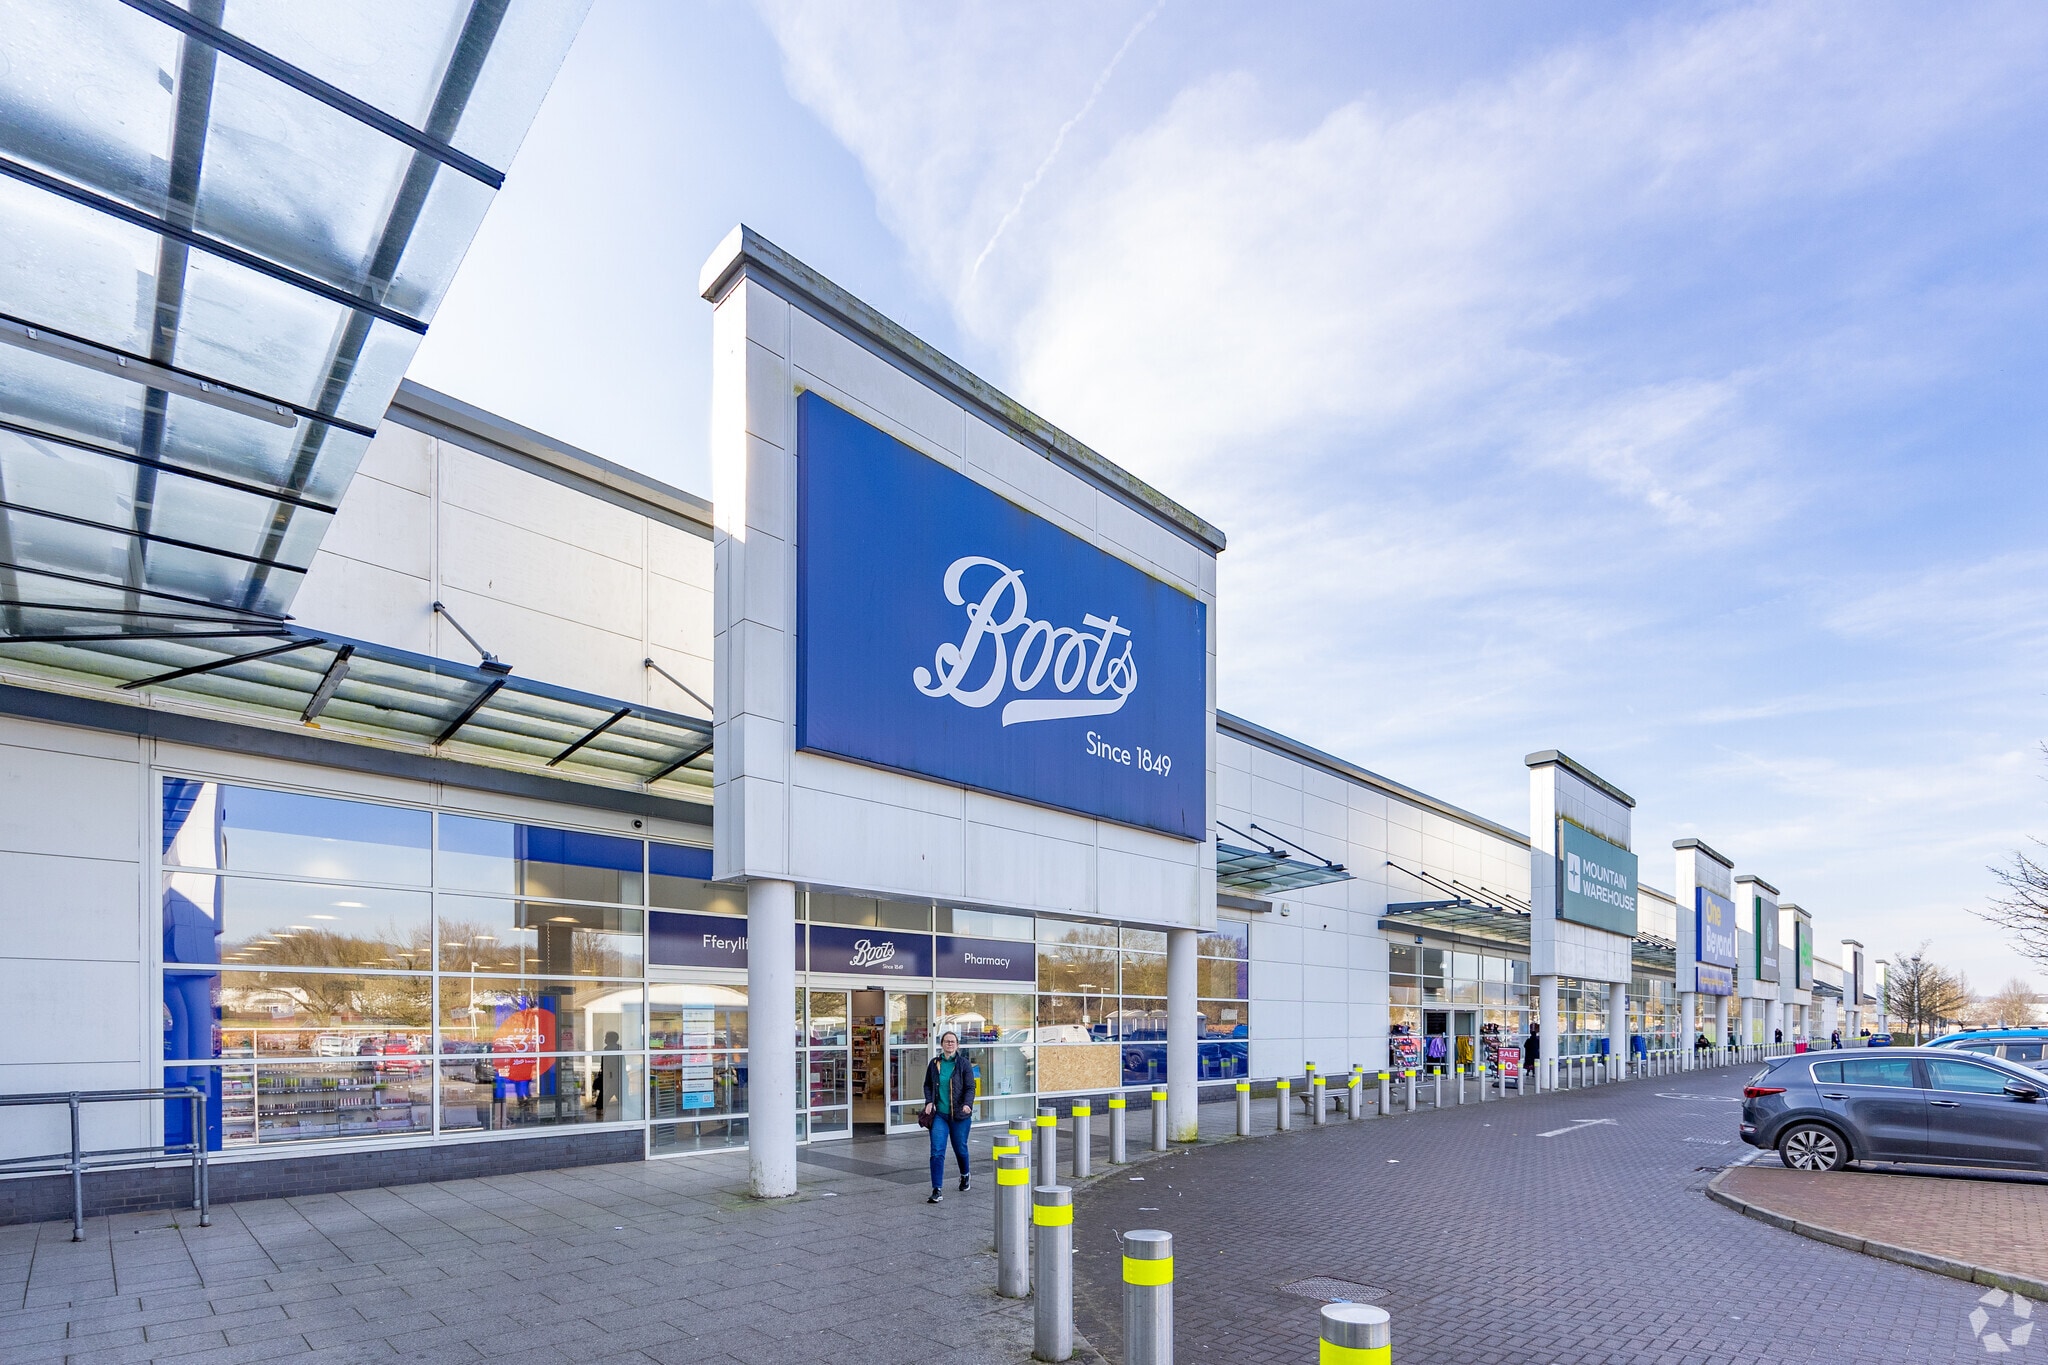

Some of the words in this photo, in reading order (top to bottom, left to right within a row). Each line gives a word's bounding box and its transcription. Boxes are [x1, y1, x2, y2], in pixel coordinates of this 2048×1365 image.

[913, 556, 1138, 727] Boots
[1086, 731, 1131, 765] Since
[1137, 747, 1172, 777] 1849
[1583, 859, 1627, 890] MOUNTAIN
[1582, 880, 1635, 912] WAREHOUSE
[1706, 896, 1721, 927] One
[849, 939, 895, 967] Boots
[1706, 925, 1732, 961] Beyond
[964, 952, 1010, 969] Pharmacy
